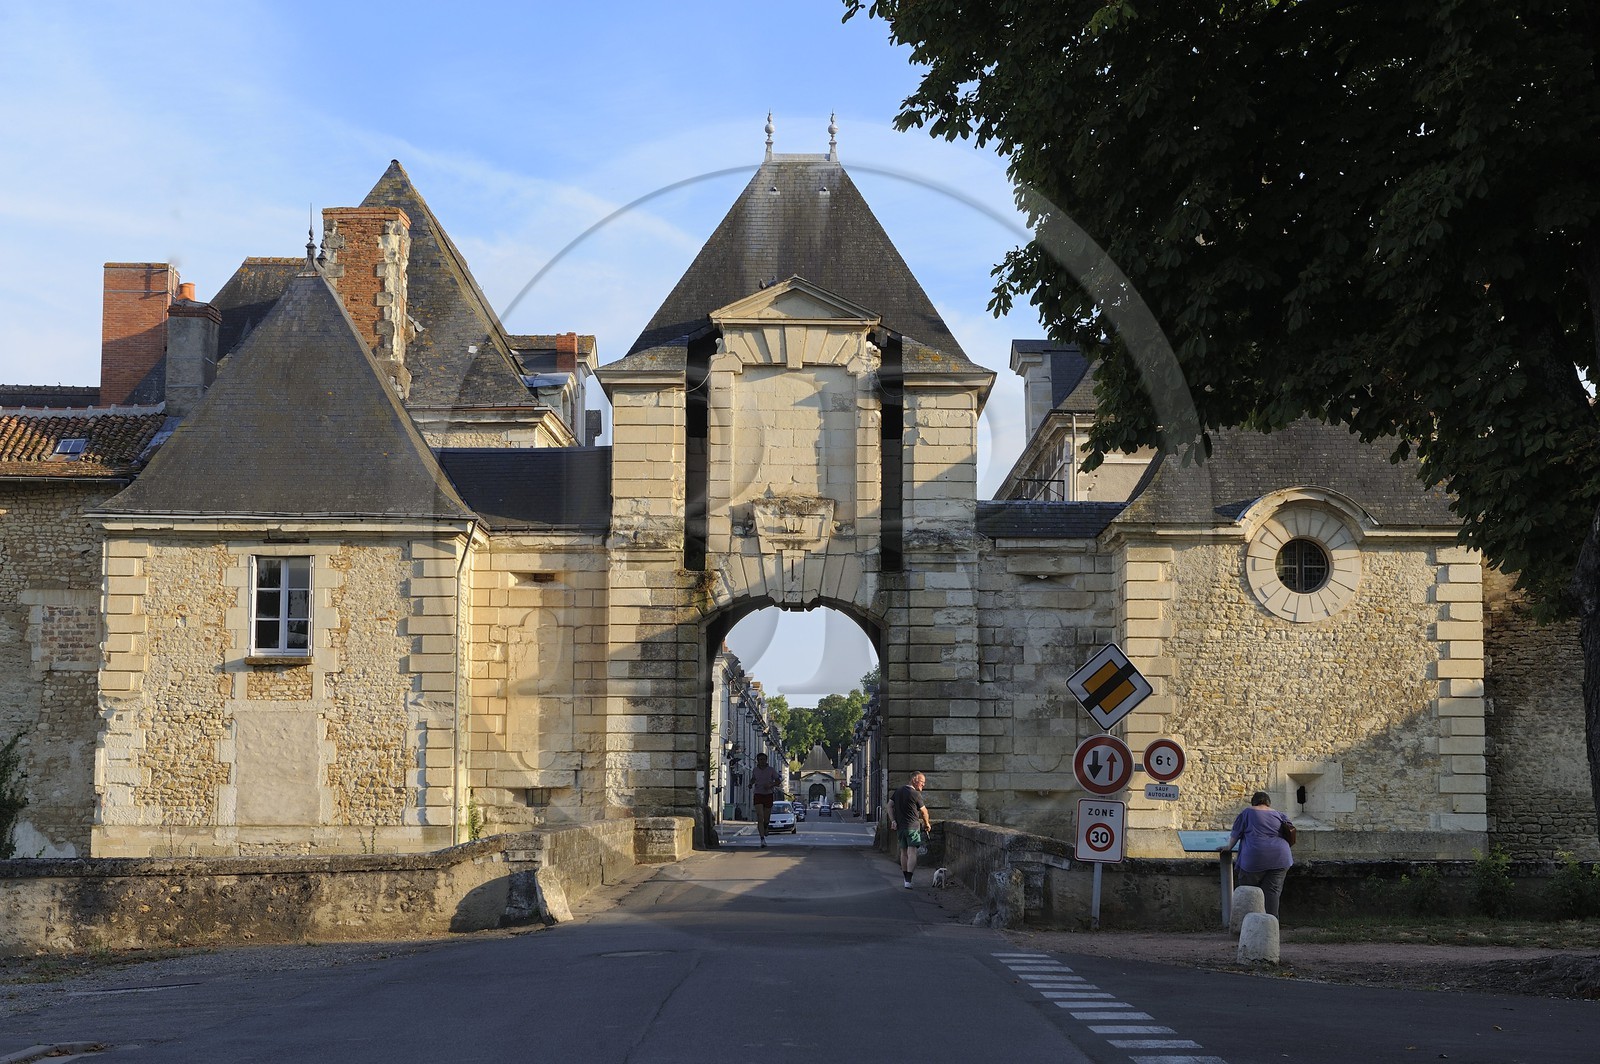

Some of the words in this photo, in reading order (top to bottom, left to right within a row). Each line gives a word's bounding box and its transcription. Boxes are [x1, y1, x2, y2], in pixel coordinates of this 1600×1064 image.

[1156, 755, 1163, 765] 6
[1166, 757, 1171, 766] t
[1088, 808, 1114, 817] ZONE
[1092, 831, 1109, 843] 30
